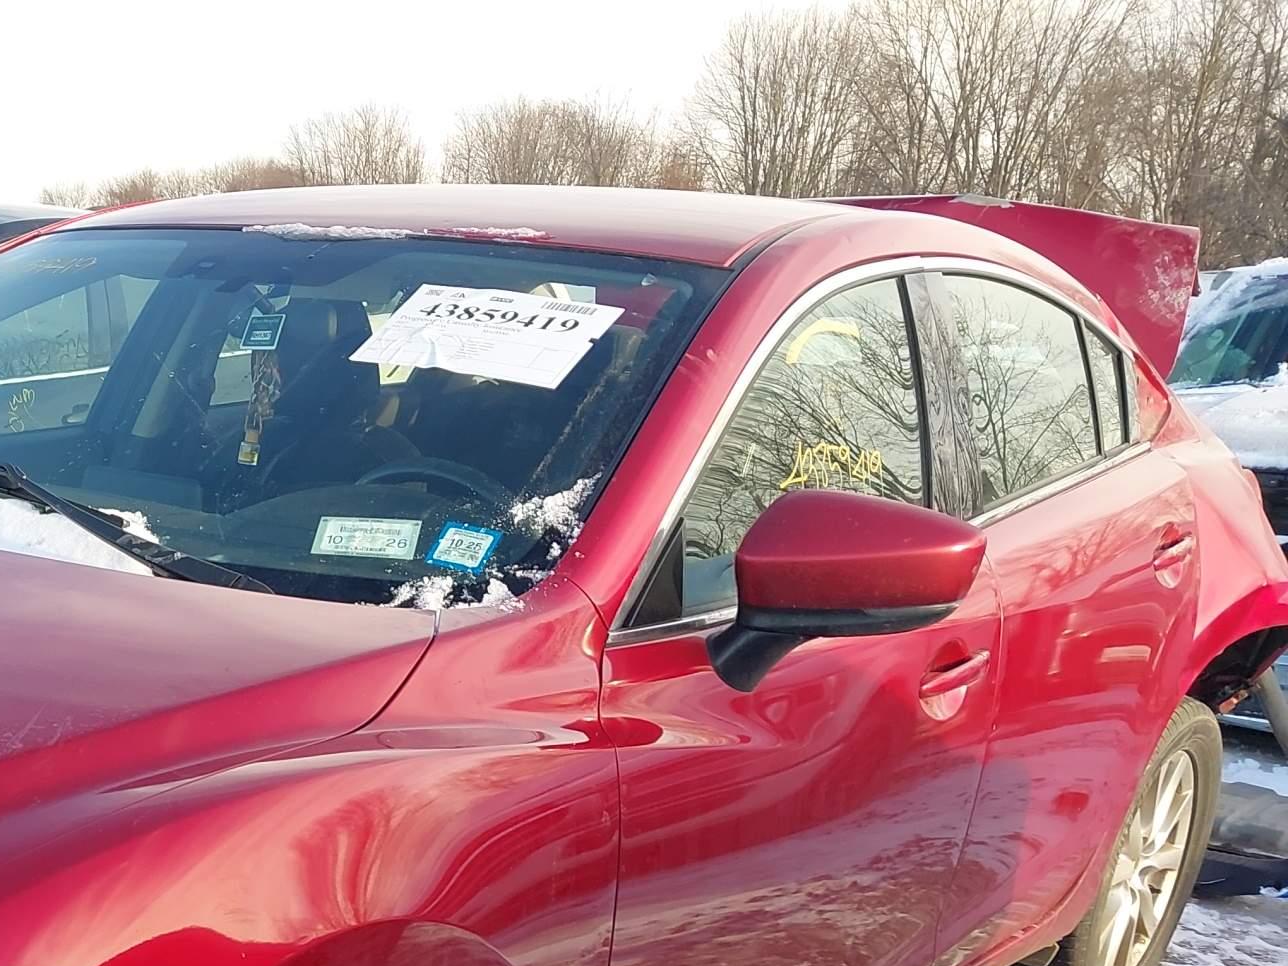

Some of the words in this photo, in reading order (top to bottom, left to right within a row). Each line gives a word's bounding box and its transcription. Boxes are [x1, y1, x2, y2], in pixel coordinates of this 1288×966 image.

[420, 302, 580, 333] 43859419
[326, 535, 343, 544] 10
[385, 539, 408, 549] 26
